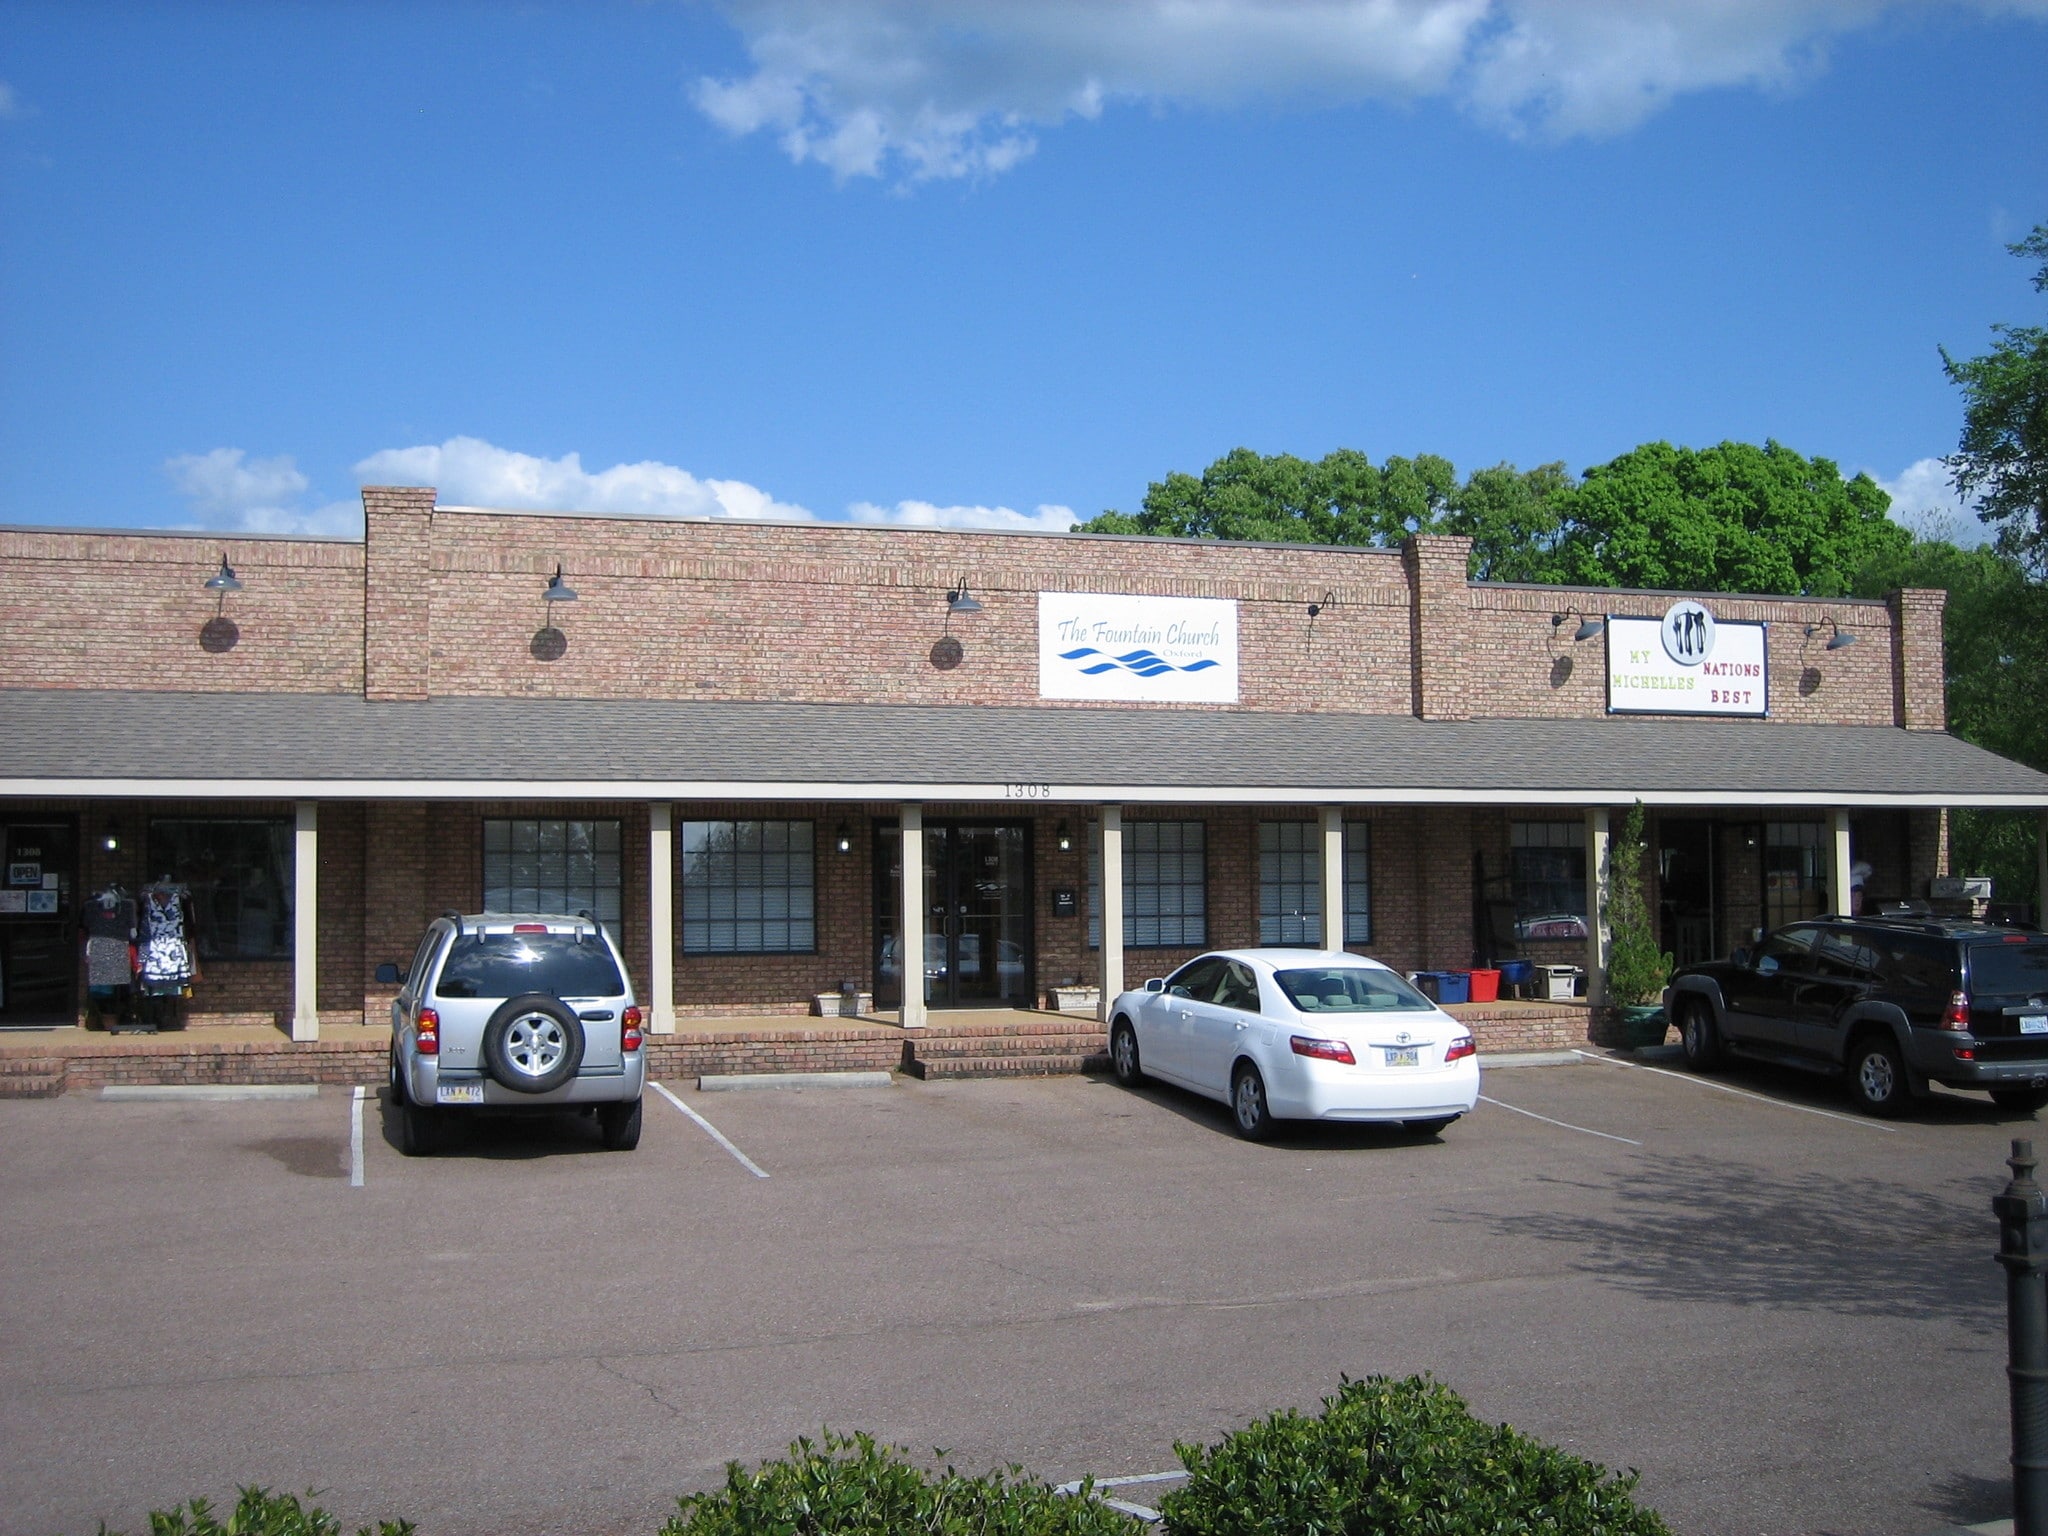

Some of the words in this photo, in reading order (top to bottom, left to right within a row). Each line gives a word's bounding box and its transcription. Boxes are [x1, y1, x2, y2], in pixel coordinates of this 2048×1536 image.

[1057, 616, 1088, 643] The
[1092, 621, 1161, 645] Fountain
[1166, 620, 1219, 647] Church
[1162, 649, 1203, 658] Oxford
[1630, 650, 1650, 664] MY
[1703, 662, 1760, 677] NATIONS
[1612, 674, 1695, 690] MICHELLES
[1711, 690, 1752, 704] BEST
[1005, 784, 1050, 798] 1308
